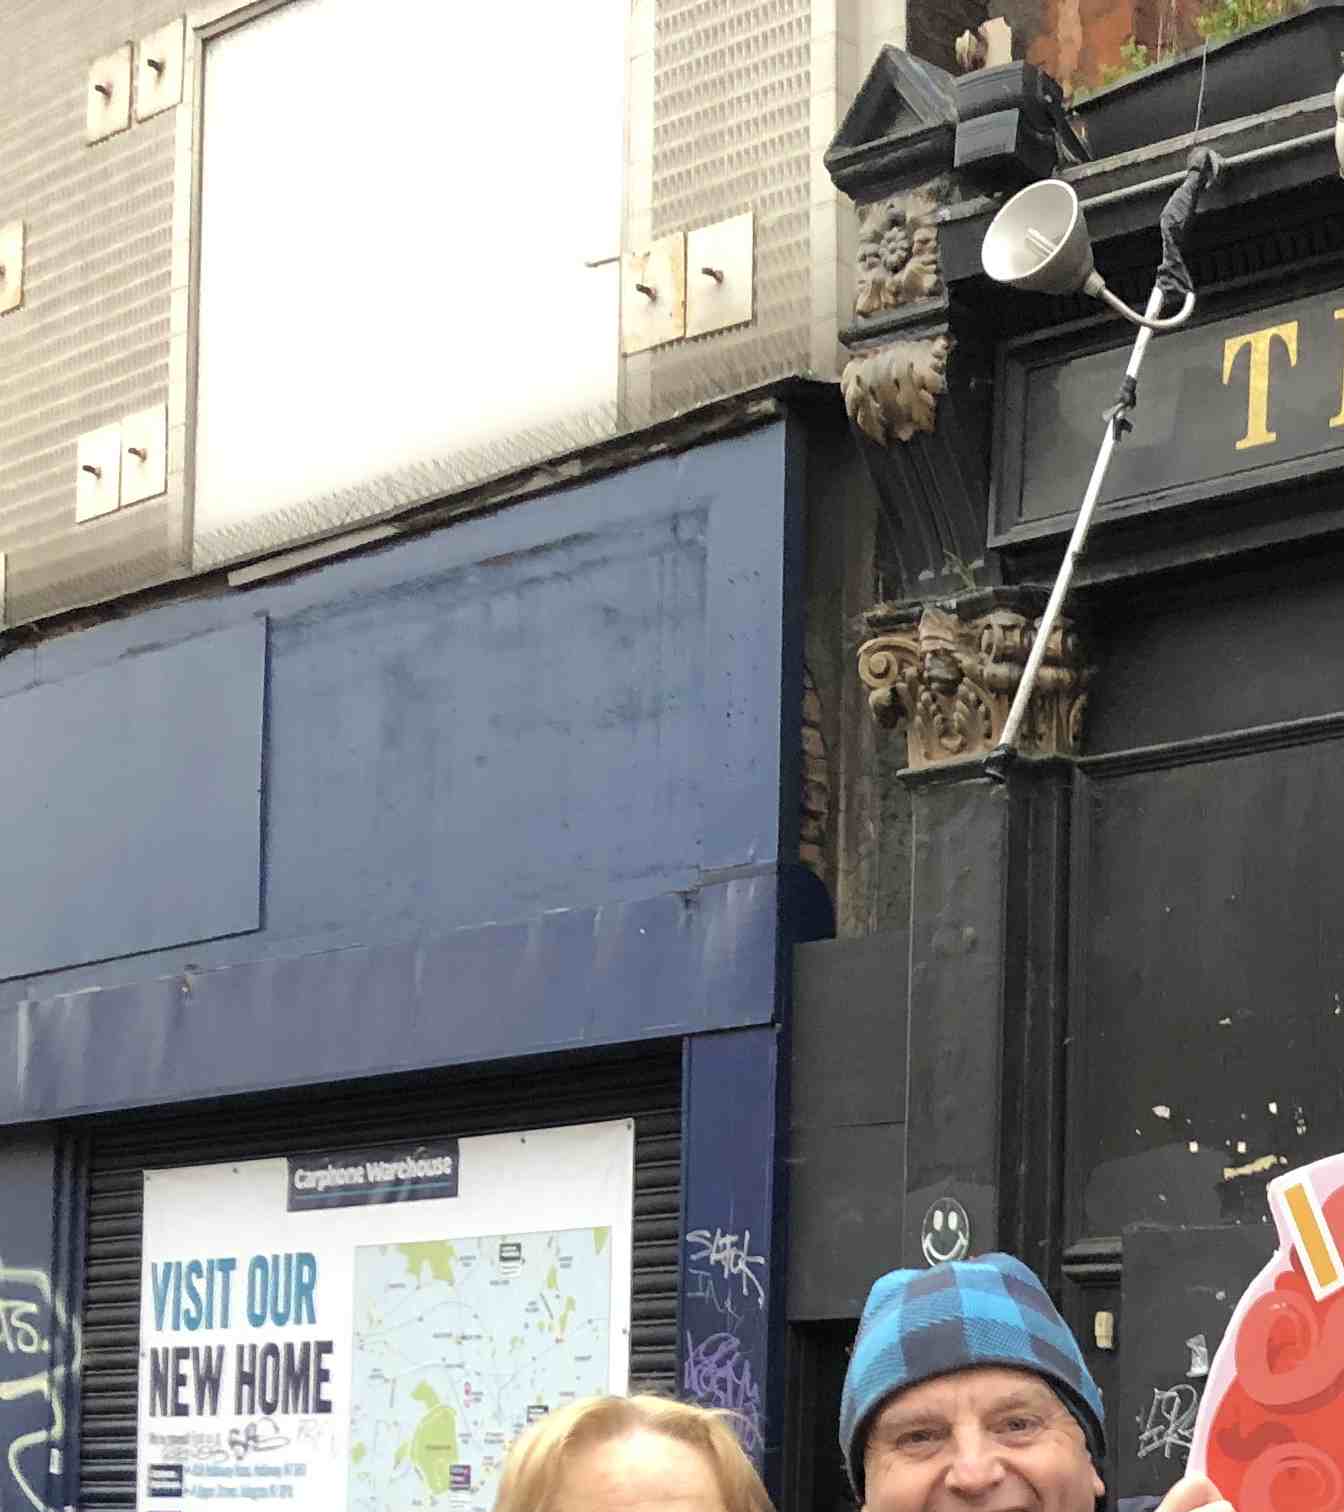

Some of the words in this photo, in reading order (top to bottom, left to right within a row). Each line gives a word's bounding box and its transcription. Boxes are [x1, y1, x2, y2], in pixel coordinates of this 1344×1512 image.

[295, 1164, 364, 1191] Carphone
[365, 1156, 453, 1183] Warehouse
[1283, 1184, 1340, 1289] I
[151, 1257, 237, 1332] VISIT
[247, 1252, 317, 1328] OUR
[149, 1344, 226, 1418] NEW
[234, 1340, 334, 1416] HOME
